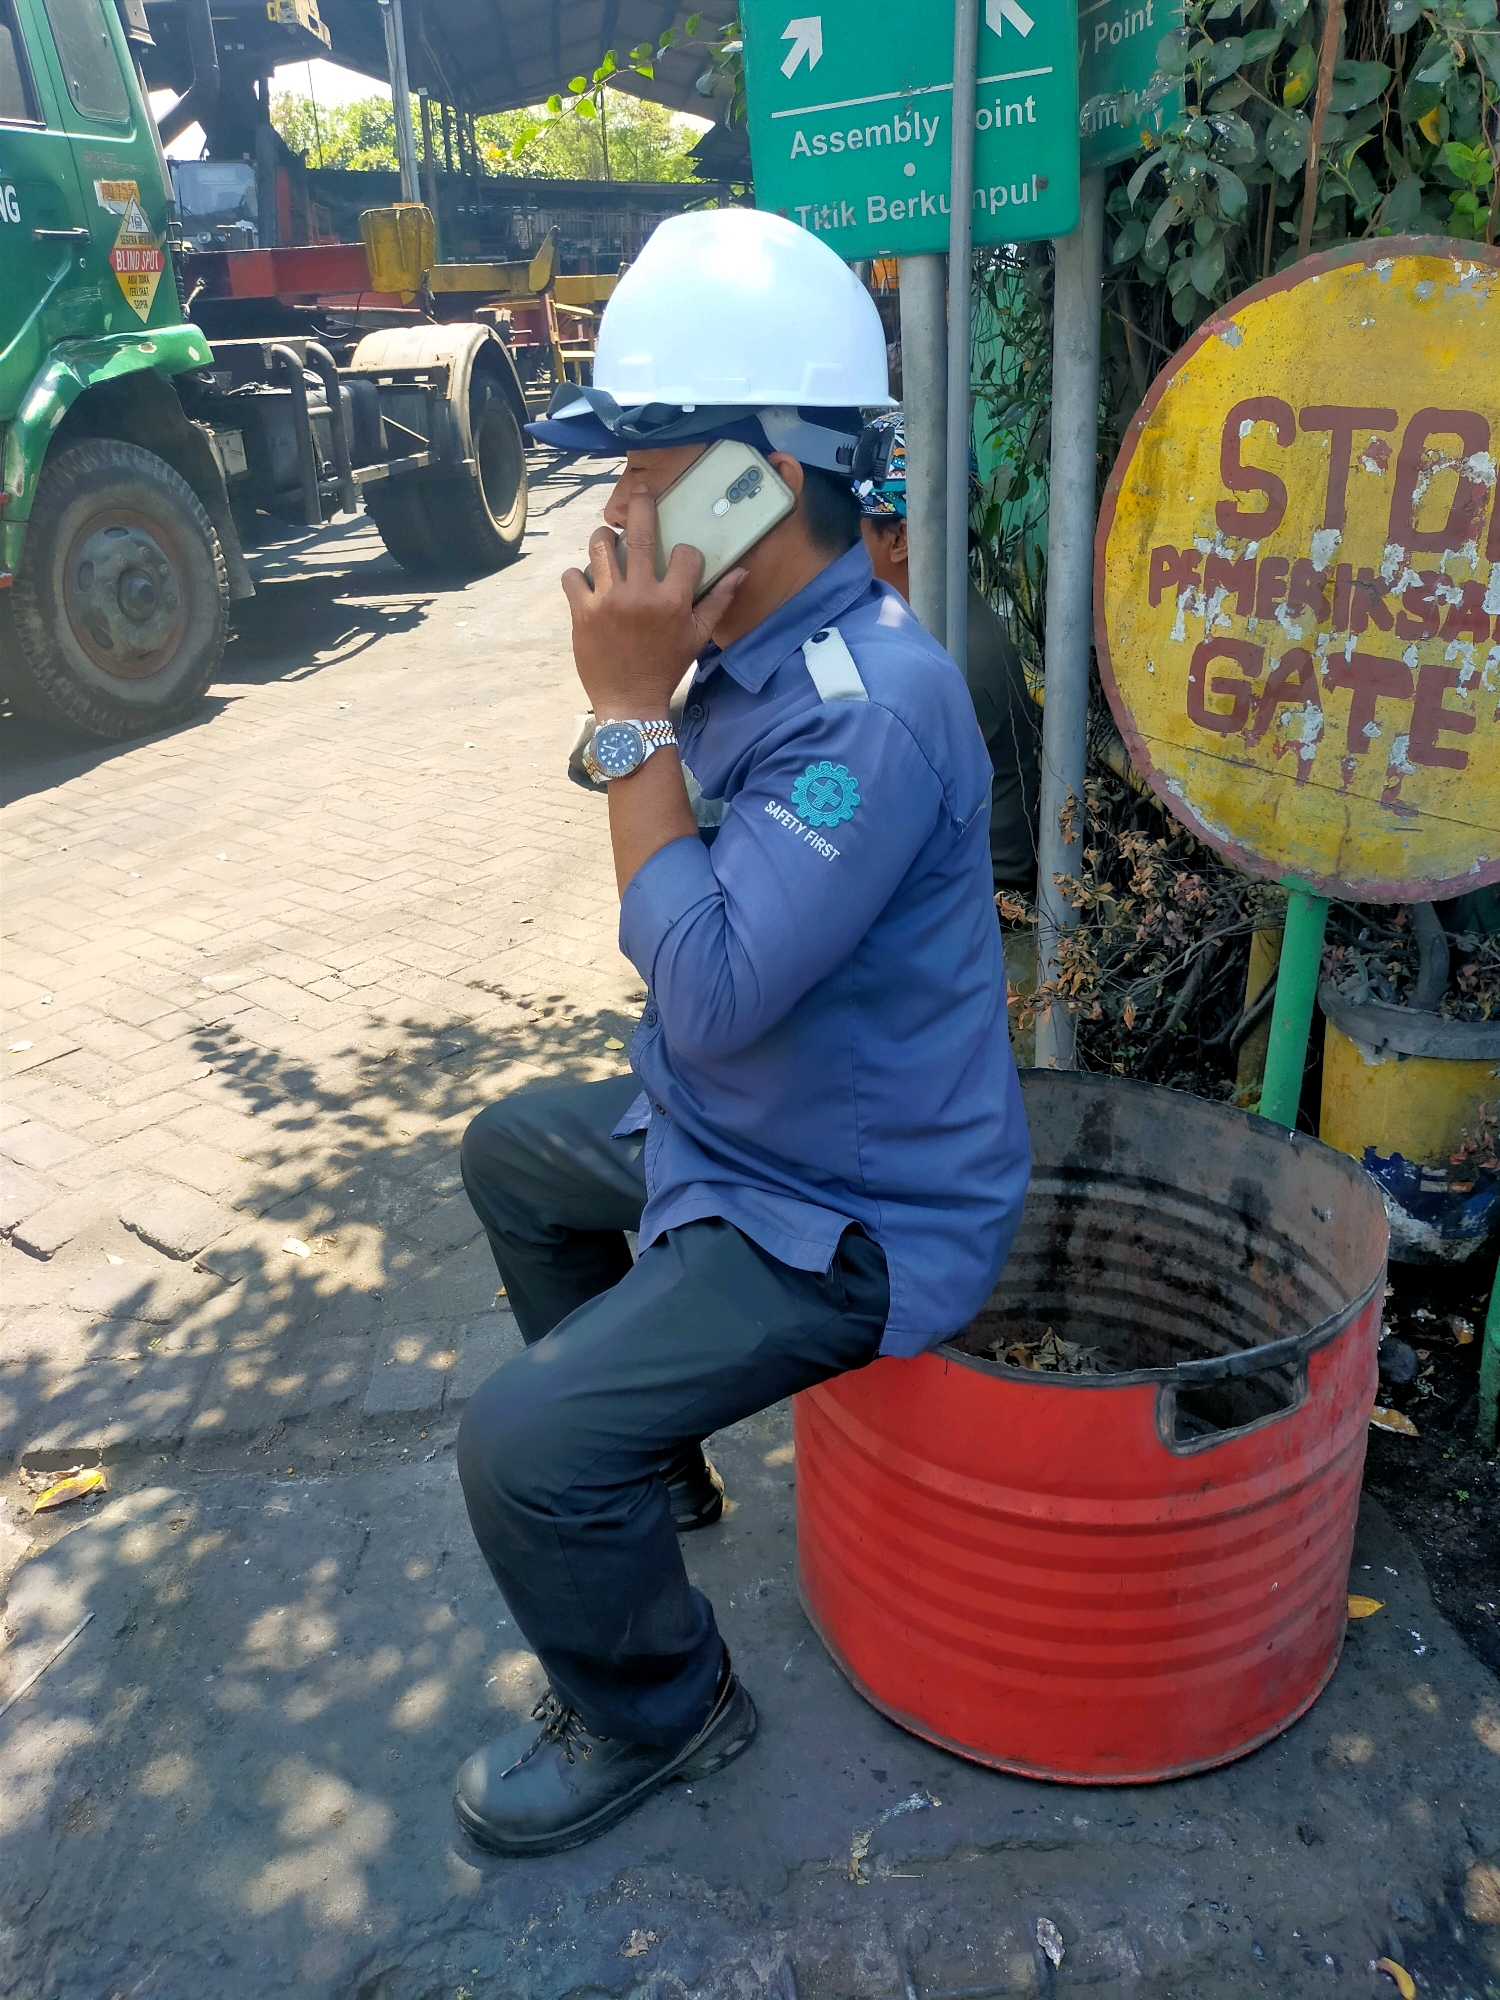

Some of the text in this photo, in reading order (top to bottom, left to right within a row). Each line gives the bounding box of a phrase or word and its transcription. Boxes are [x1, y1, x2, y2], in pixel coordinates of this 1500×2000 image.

[1094, 0, 1154, 54] Point
[790, 111, 939, 160] Assembly
[953, 95, 1037, 131] oint
[794, 200, 858, 231] Titik
[115, 250, 159, 271] BLIND SPOT
[1215, 395, 1500, 561] STO
[1148, 544, 1500, 644] PEMERIKSA
[1187, 637, 1478, 770] GATE
[764, 800, 841, 862] SAFETY FIRST
